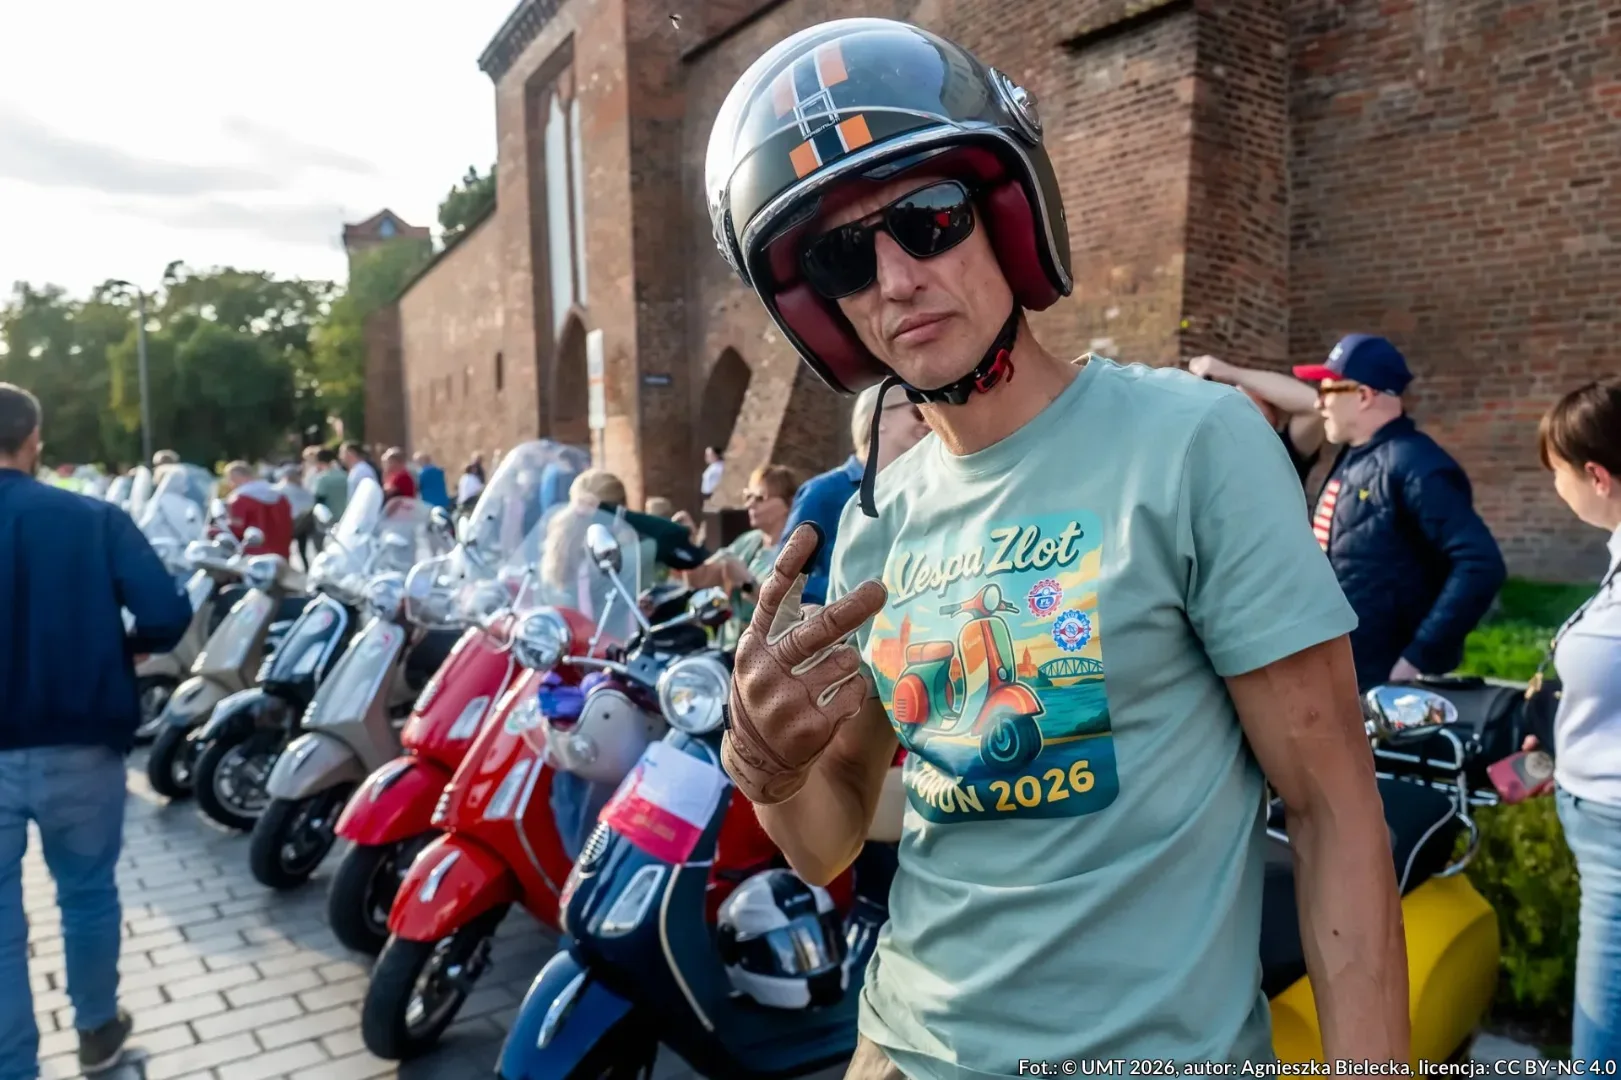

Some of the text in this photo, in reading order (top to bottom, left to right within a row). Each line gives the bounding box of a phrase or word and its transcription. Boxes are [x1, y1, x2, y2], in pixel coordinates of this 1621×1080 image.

[892, 520, 1084, 608] Vespa Zlot
[989, 760, 1095, 812] 2026
